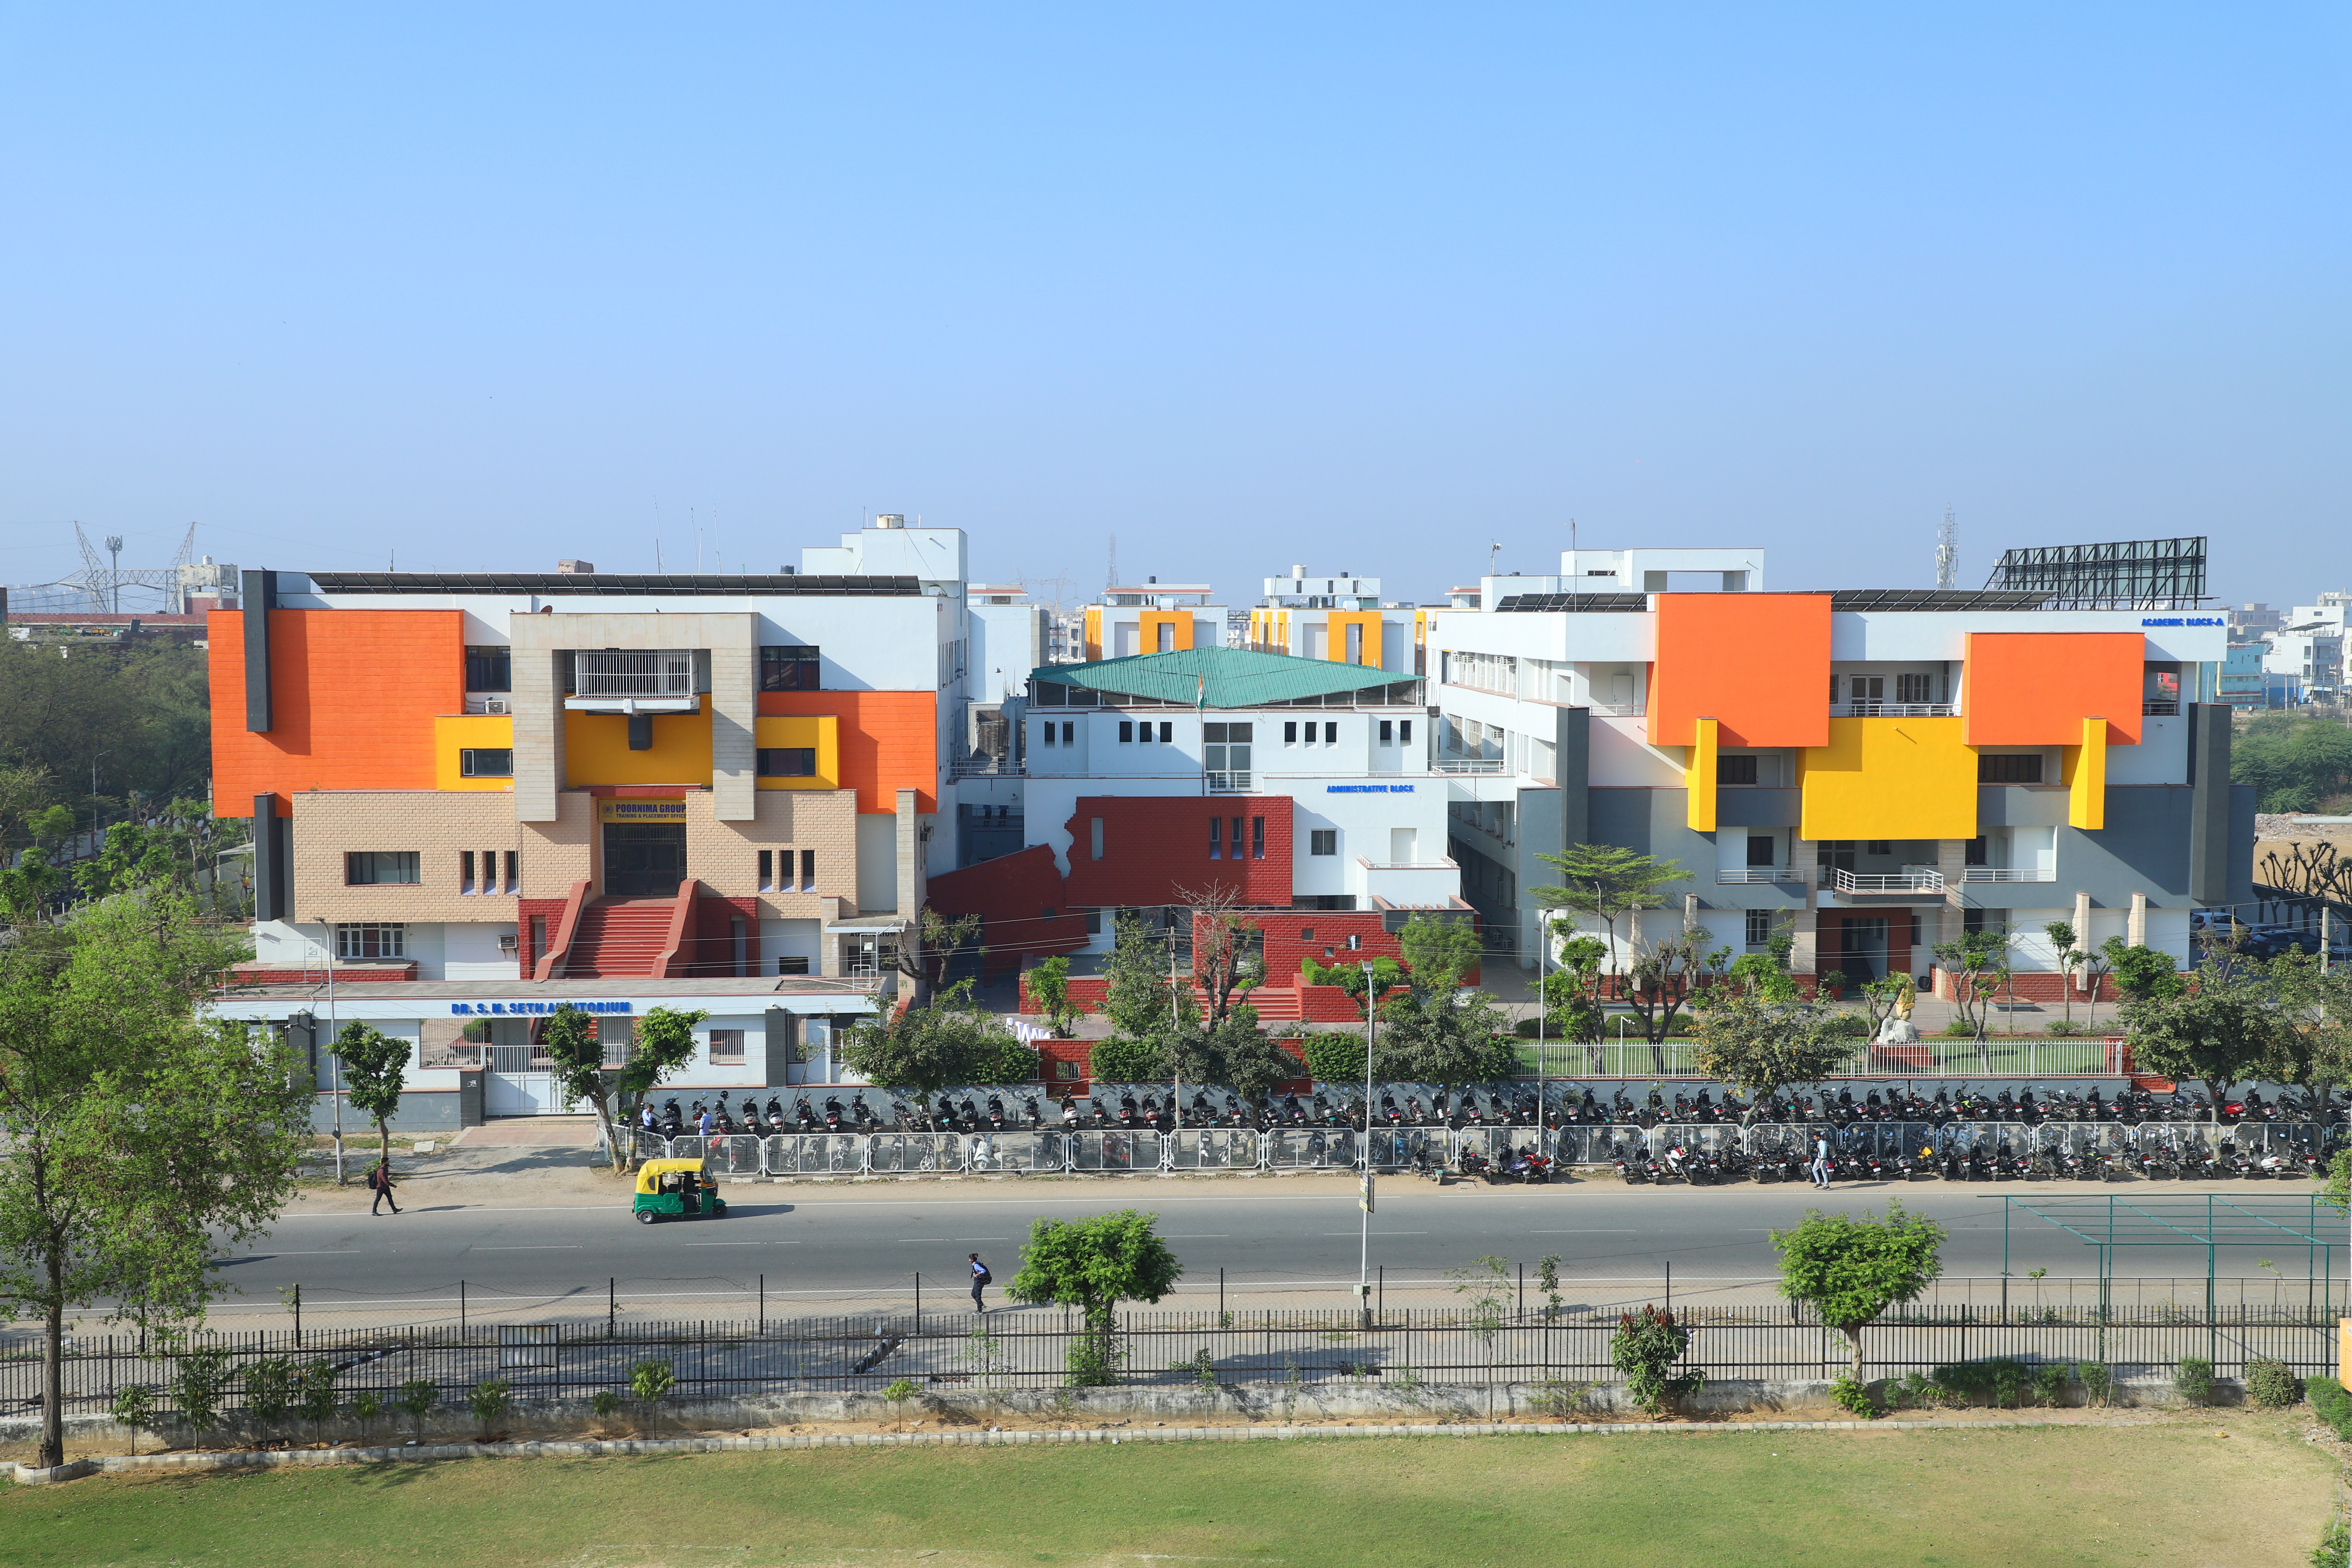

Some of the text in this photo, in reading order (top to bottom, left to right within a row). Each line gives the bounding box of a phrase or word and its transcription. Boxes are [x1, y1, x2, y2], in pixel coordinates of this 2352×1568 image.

[616, 804, 686, 813] POORNIMA GROUP
[452, 1002, 629, 1014] DR. S. M. SETH AITORIUM
